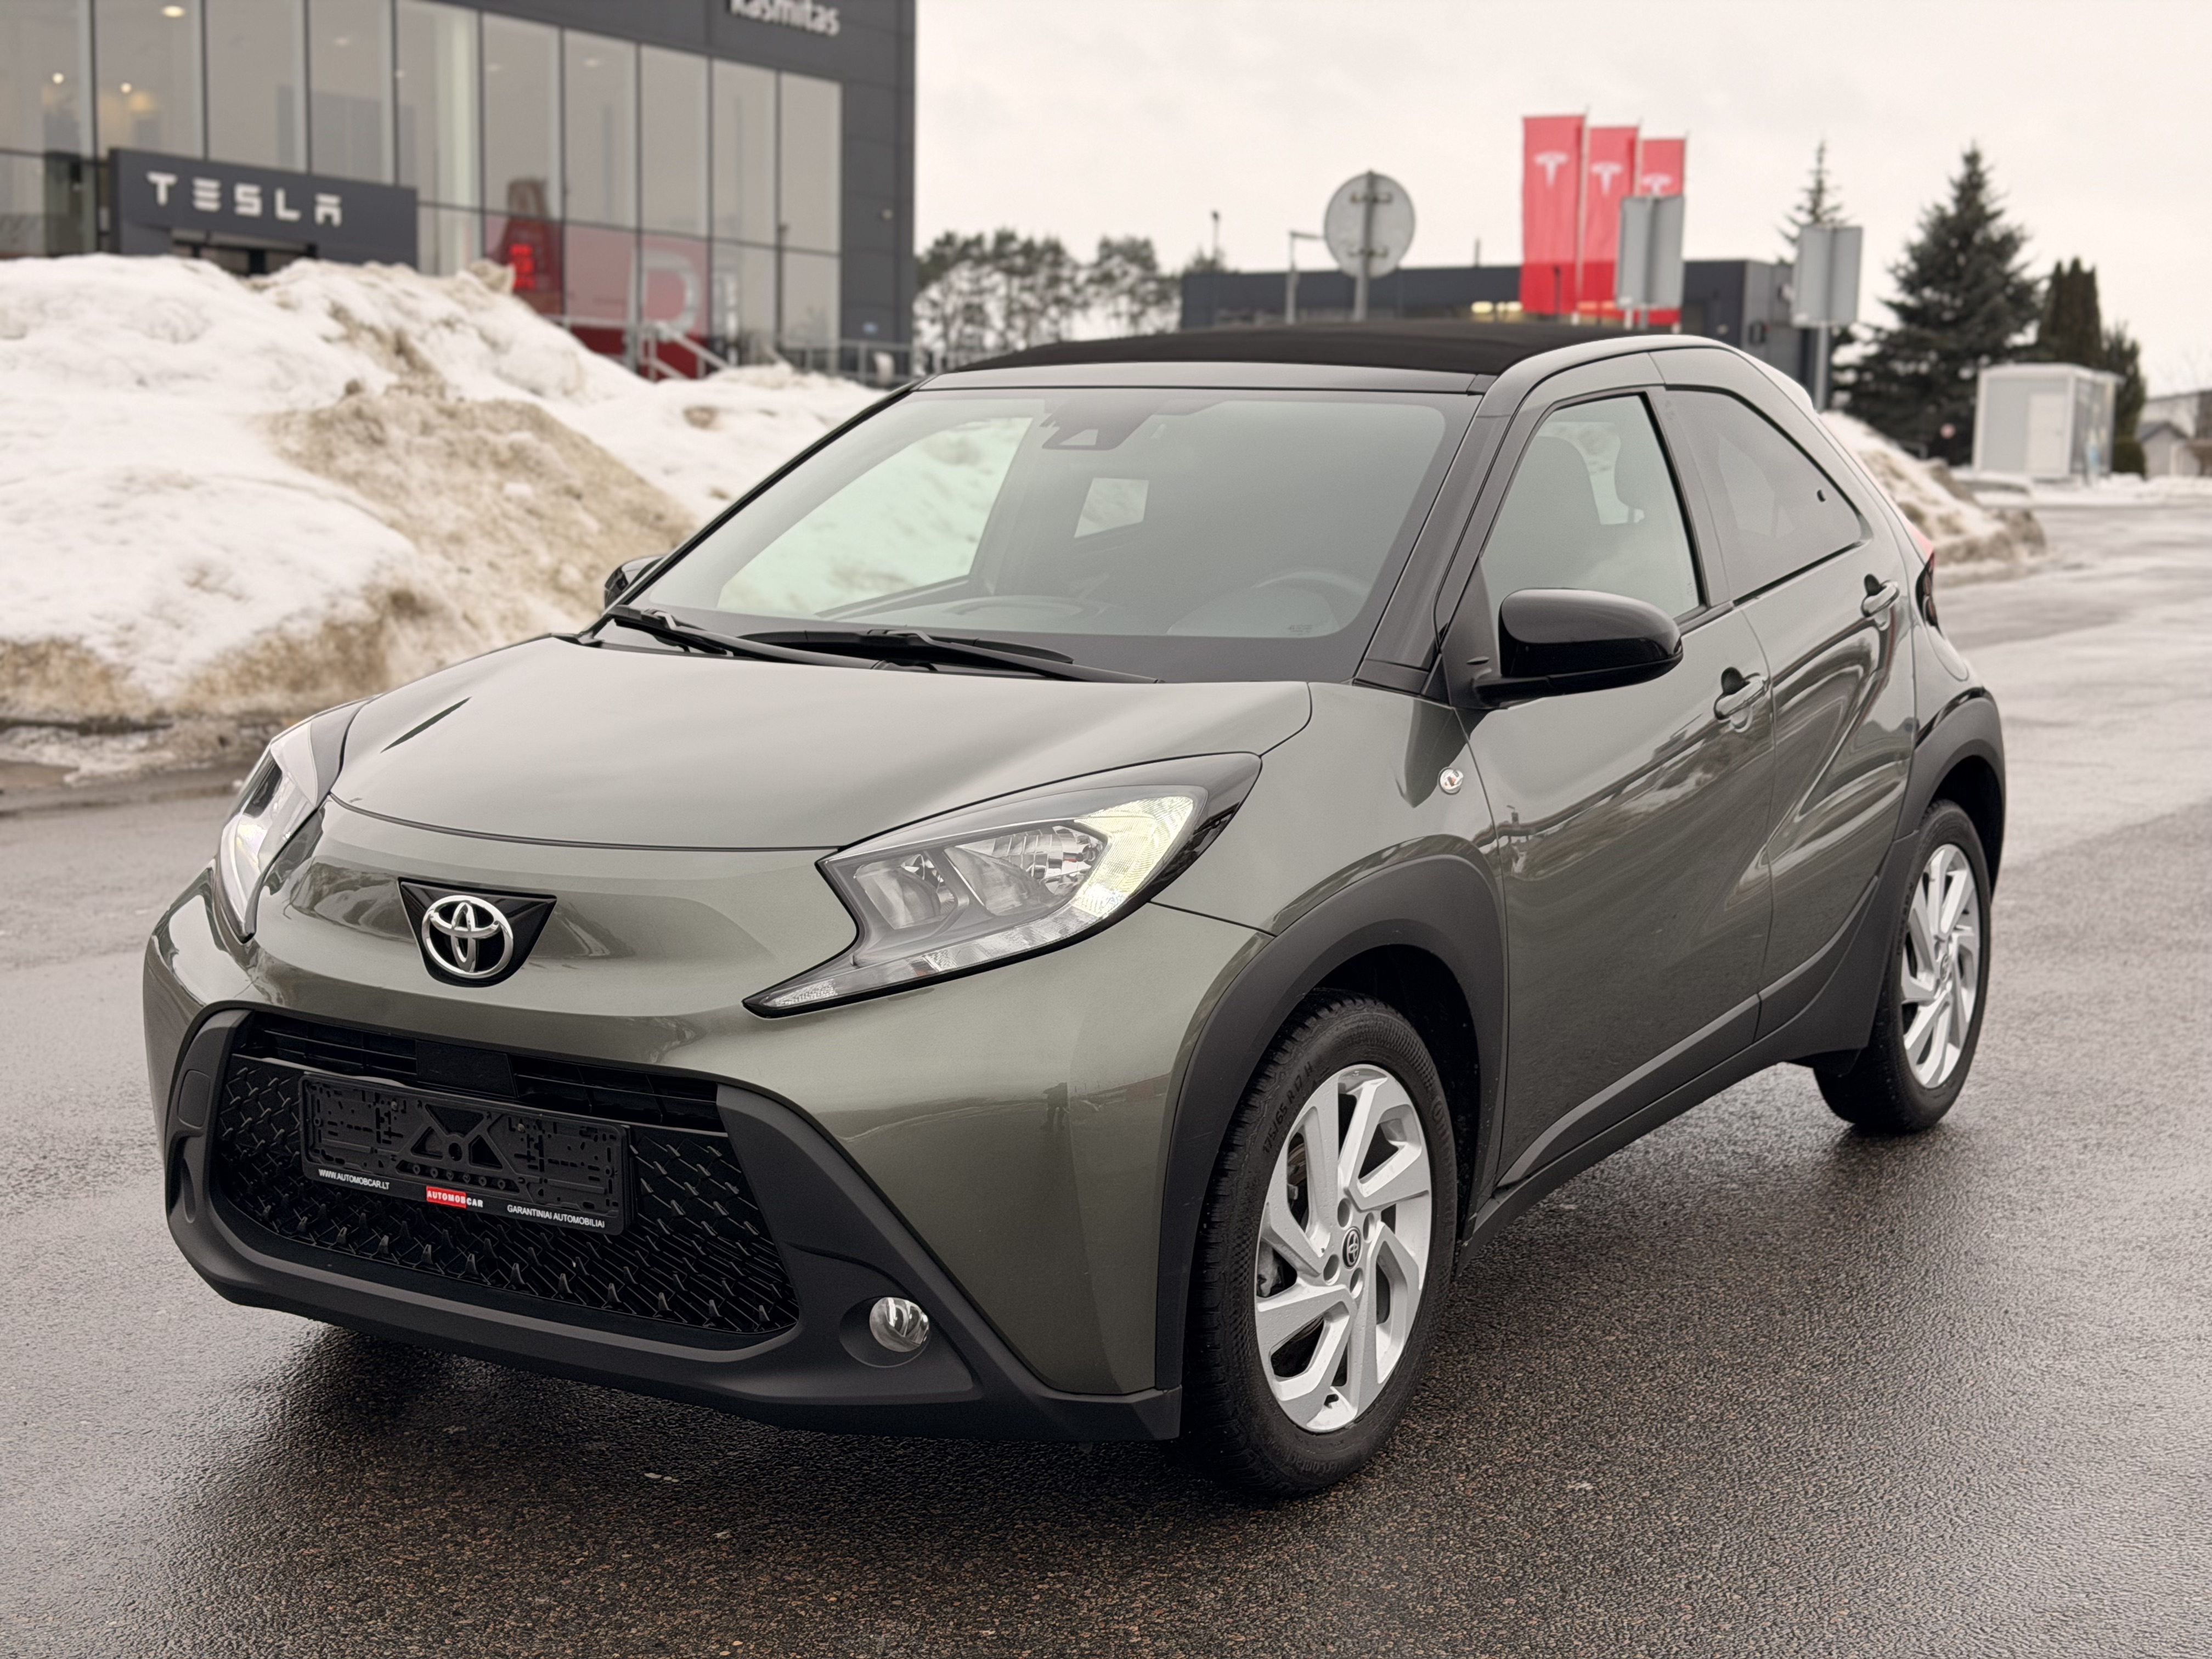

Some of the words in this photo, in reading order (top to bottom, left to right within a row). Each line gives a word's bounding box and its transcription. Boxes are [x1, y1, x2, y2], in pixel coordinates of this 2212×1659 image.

[146, 171, 341, 227] TESLA
[1263, 1102, 1288, 1153] 175/65
[318, 1169, 390, 1190] WWW.AUTOMOBCAR.LT
[427, 1190, 483, 1207] AUTOMOBCAR
[507, 1204, 552, 1220] GARANTINIAI
[553, 1212, 605, 1228] AUTOMOBILIAI
